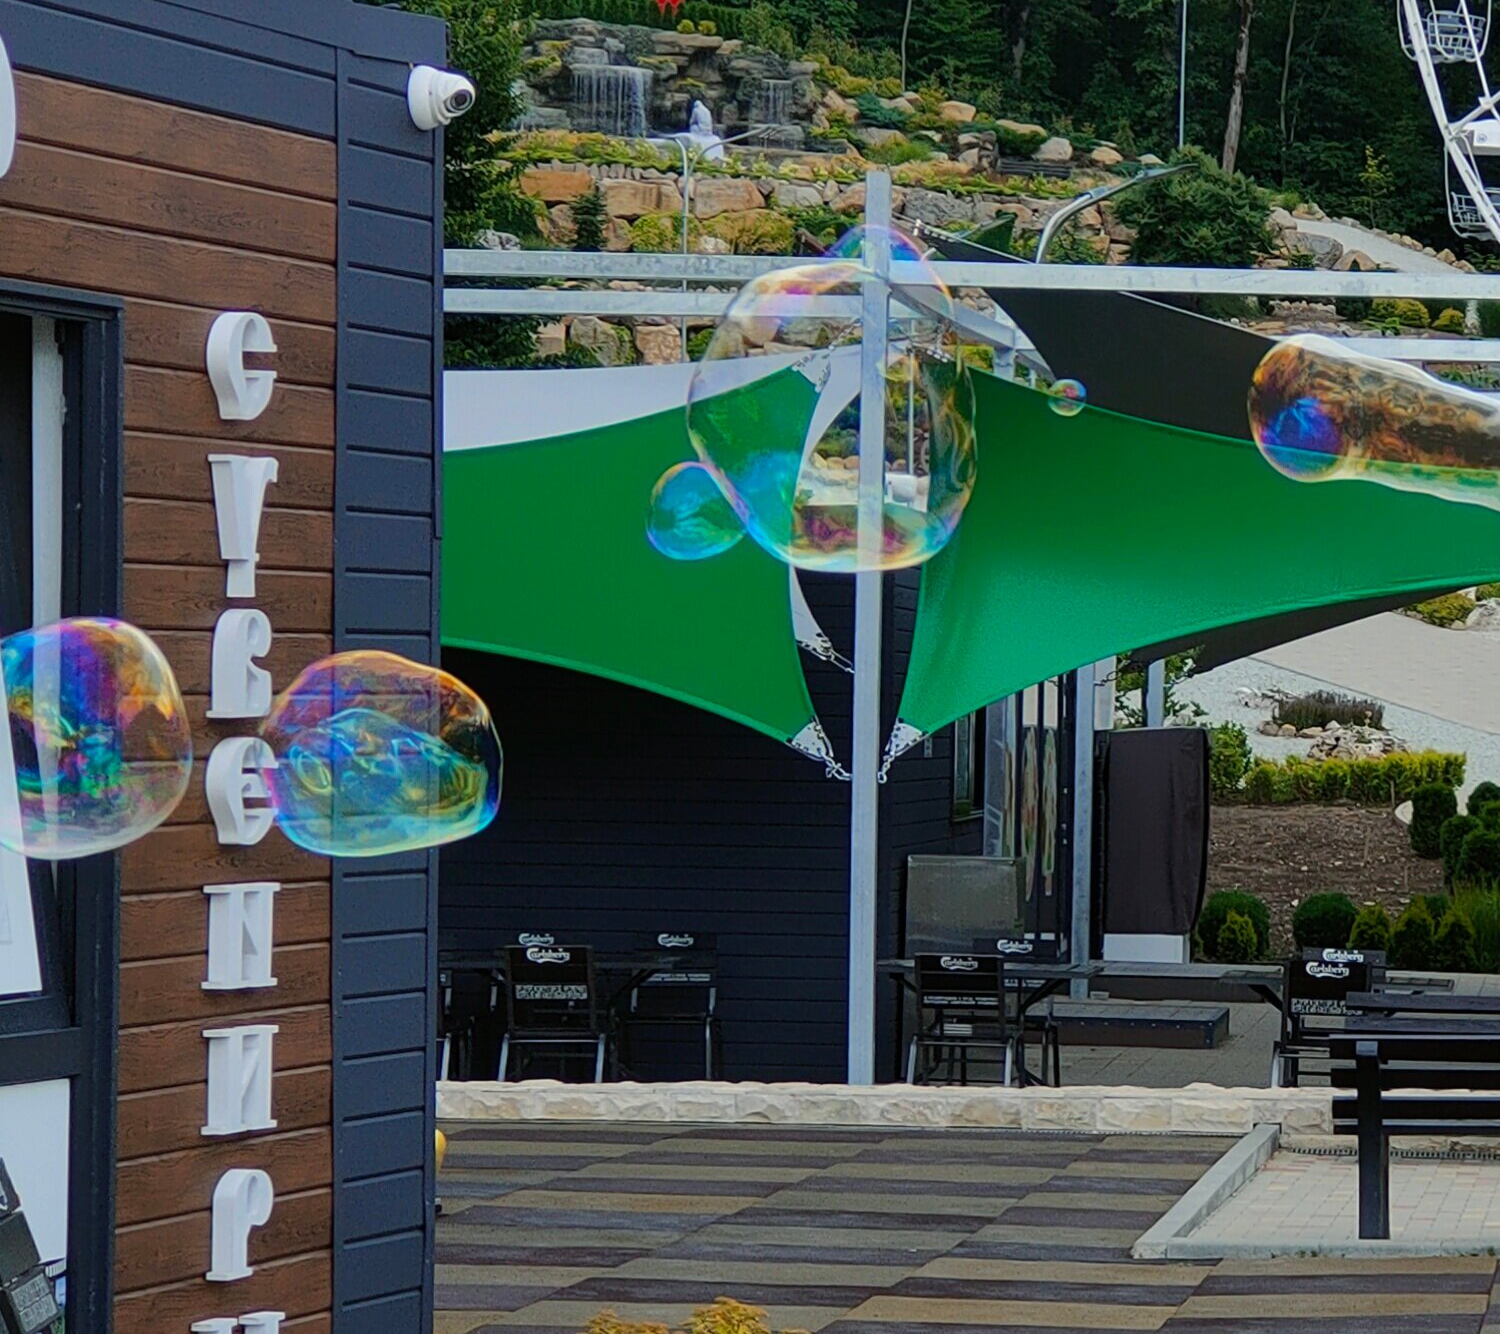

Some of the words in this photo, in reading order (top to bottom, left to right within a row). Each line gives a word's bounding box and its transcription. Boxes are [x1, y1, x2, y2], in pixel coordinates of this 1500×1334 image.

[658, 933, 694, 947] Carlsberg
[997, 939, 1033, 954] Carlsberg
[527, 947, 571, 964] Carlsberg
[1322, 948, 1364, 963] Carlsberg
[940, 956, 979, 971] Carlsberg
[1305, 961, 1350, 979] Carlsberg
